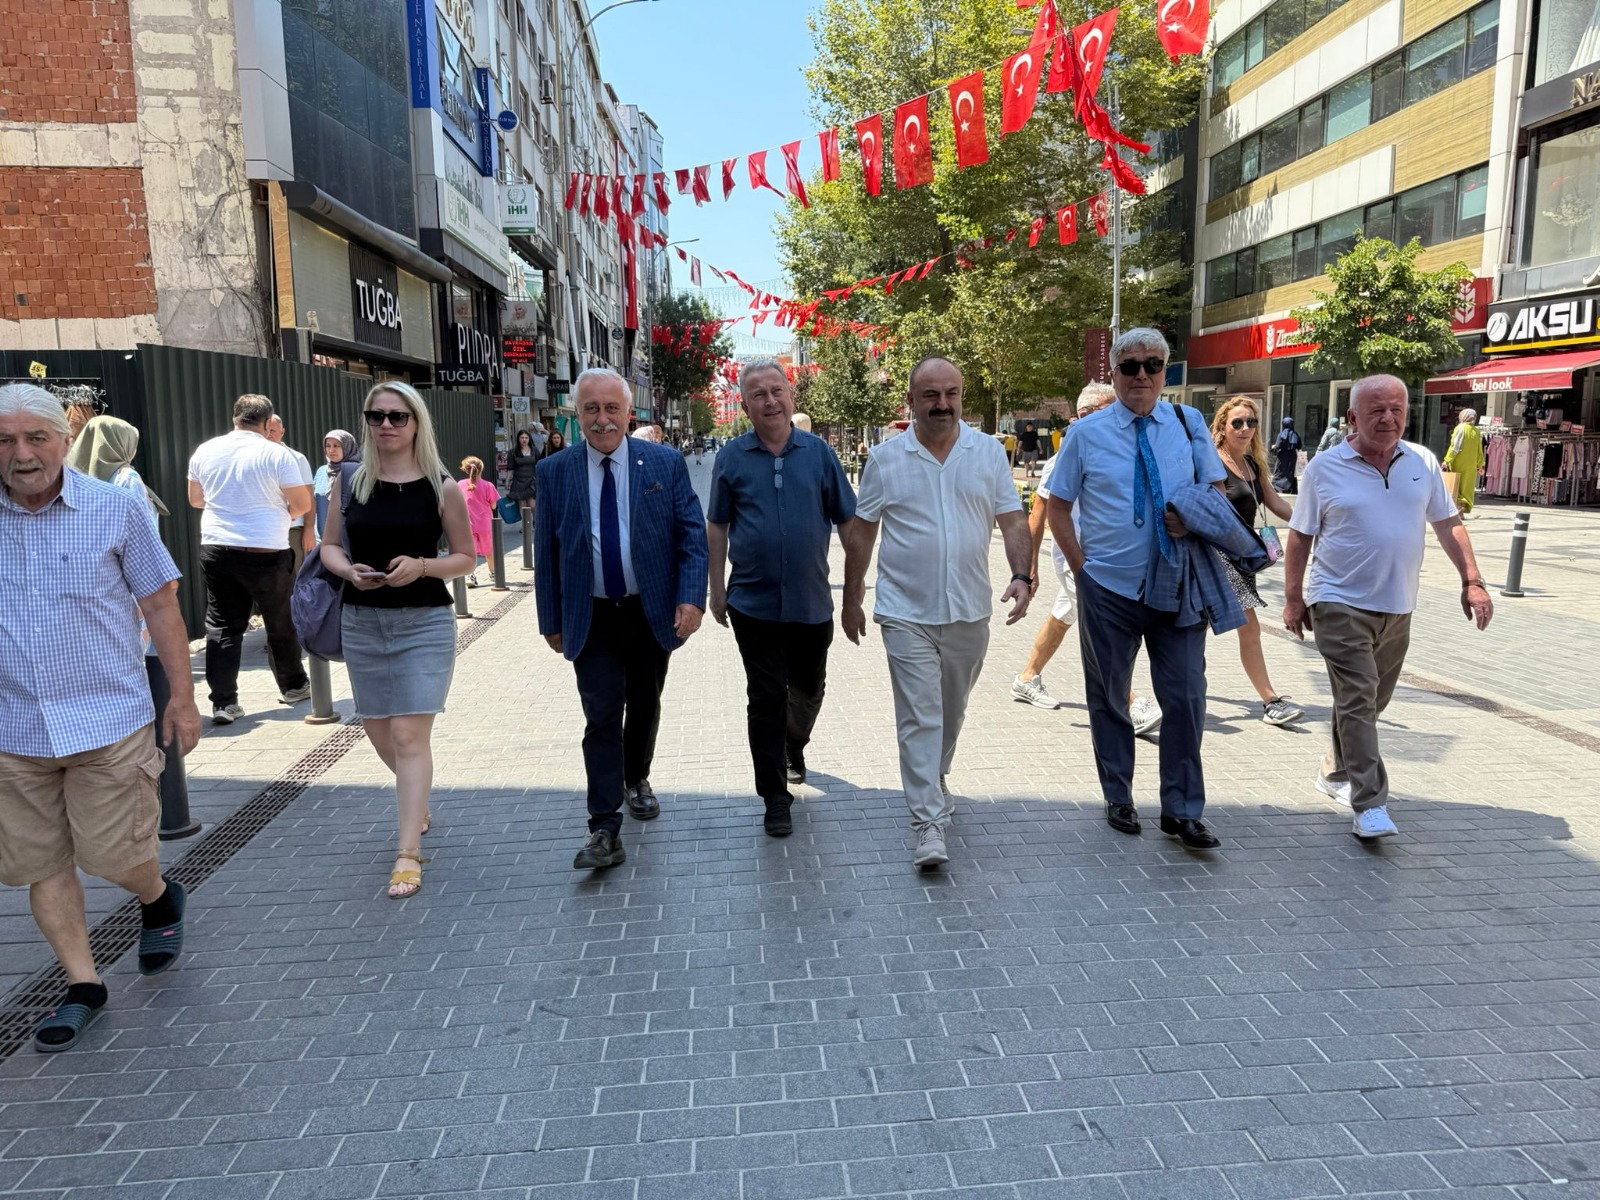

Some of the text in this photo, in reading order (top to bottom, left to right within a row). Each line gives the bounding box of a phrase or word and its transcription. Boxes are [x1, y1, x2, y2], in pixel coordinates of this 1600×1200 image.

[414, 18, 423, 46] NAS
[417, 48, 426, 100] BRIDAL
[356, 278, 403, 331] TUĞBA
[1507, 299, 1593, 340] AKSU
[438, 368, 485, 382] TUĞBA
[1472, 377, 1513, 391] bel look
